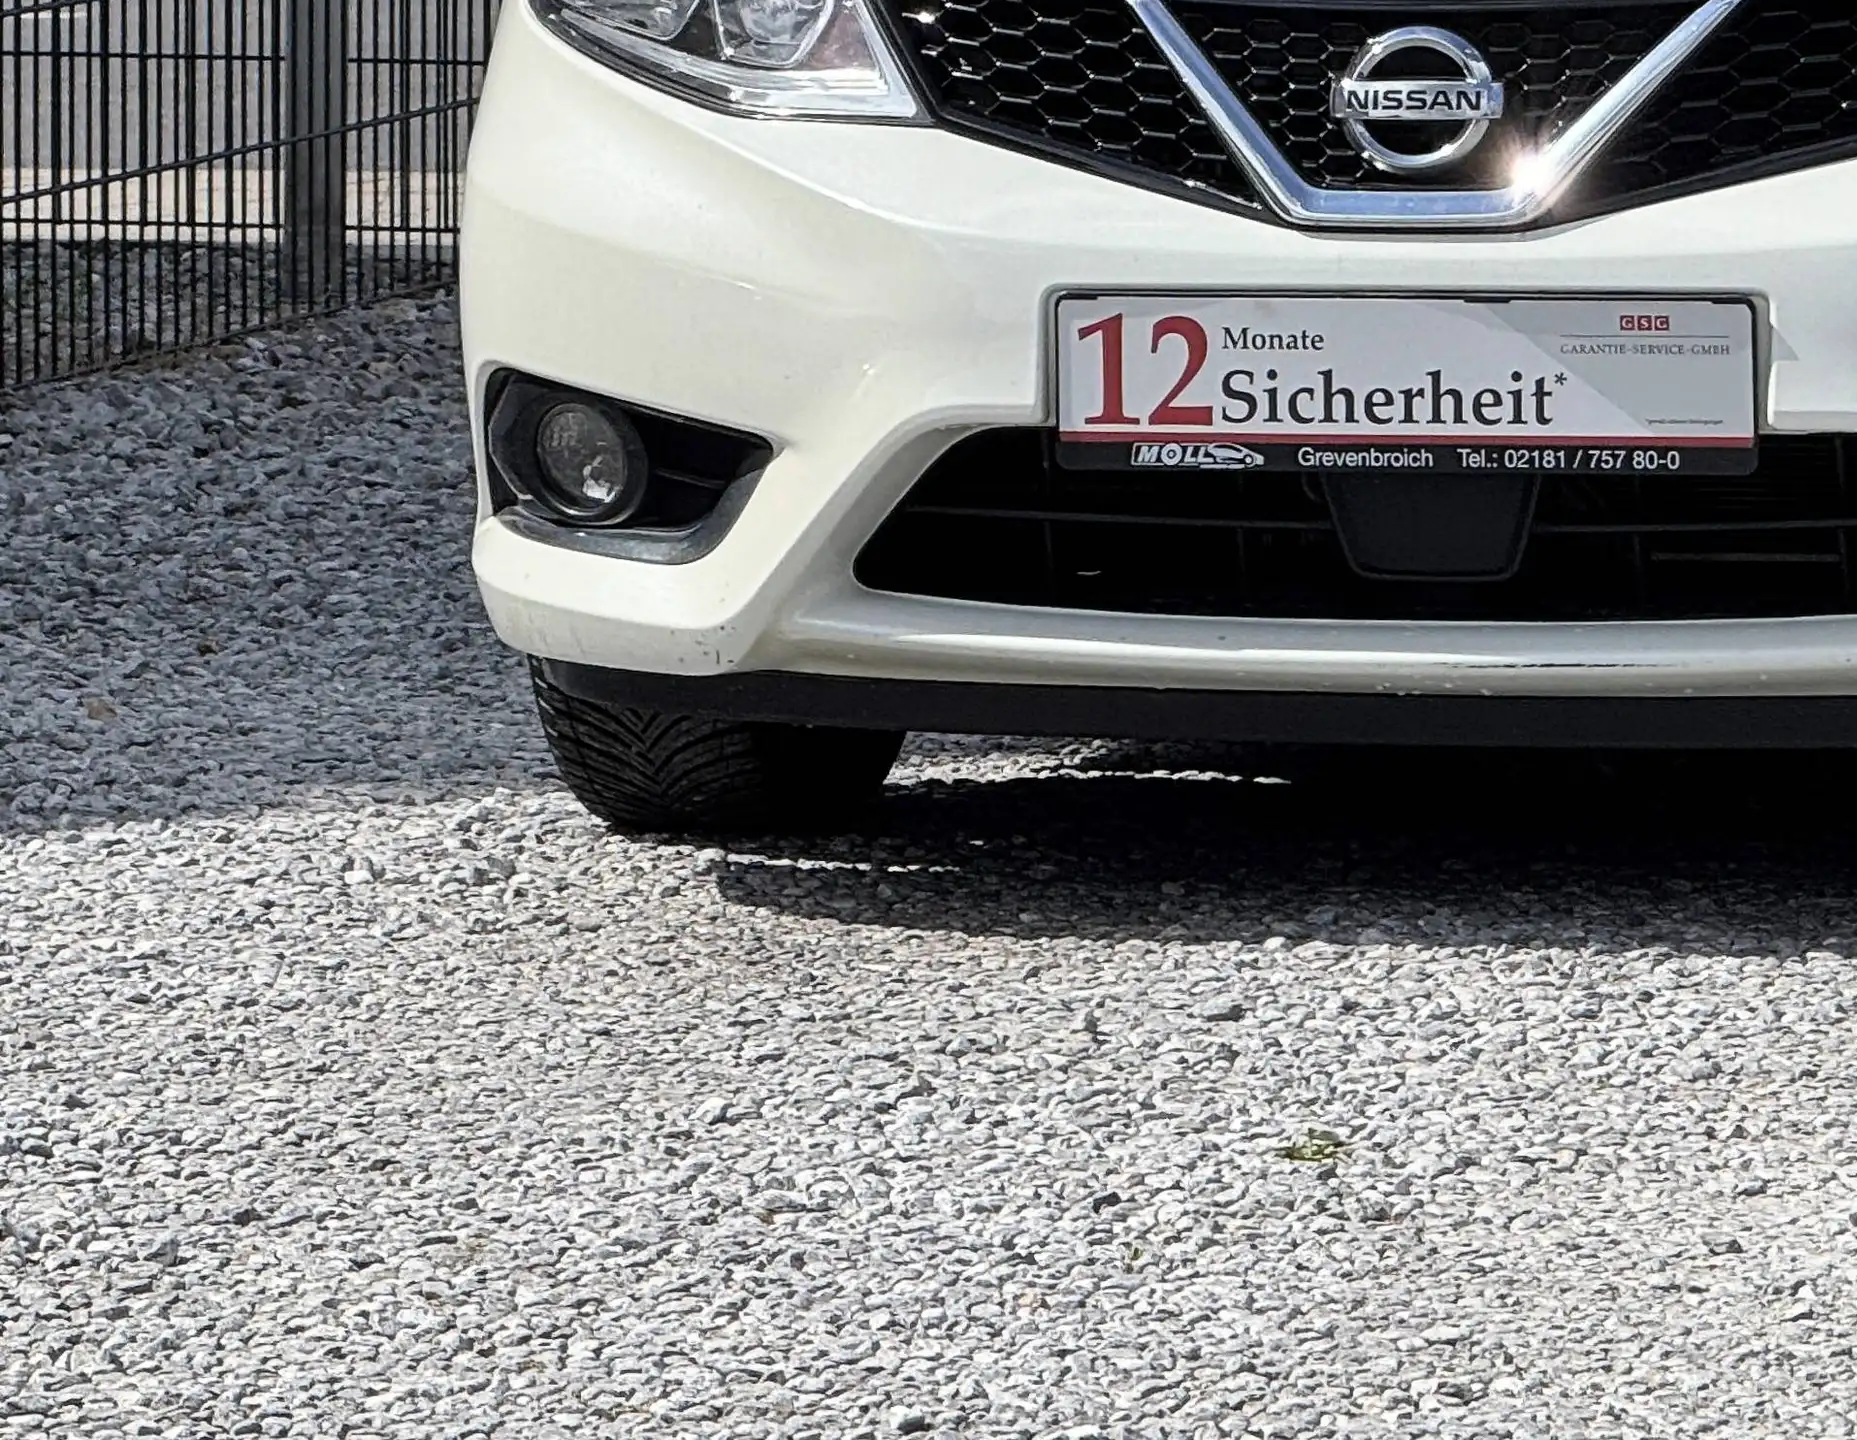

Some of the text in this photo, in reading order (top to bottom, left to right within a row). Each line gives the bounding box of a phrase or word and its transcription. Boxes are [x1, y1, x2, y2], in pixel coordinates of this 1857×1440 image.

[1346, 89, 1482, 111] NISSAN
[1620, 315, 1670, 331] GSG
[1221, 326, 1325, 351] Monate
[1076, 312, 1214, 427] 12
[1136, 443, 1215, 466] MOLL
[1297, 447, 1434, 469] Grevenbroich
[1456, 448, 1498, 469] Tel.:
[1503, 449, 1567, 470] 02181
[1588, 450, 1627, 470] 757
[1632, 451, 1680, 471] 80-0
